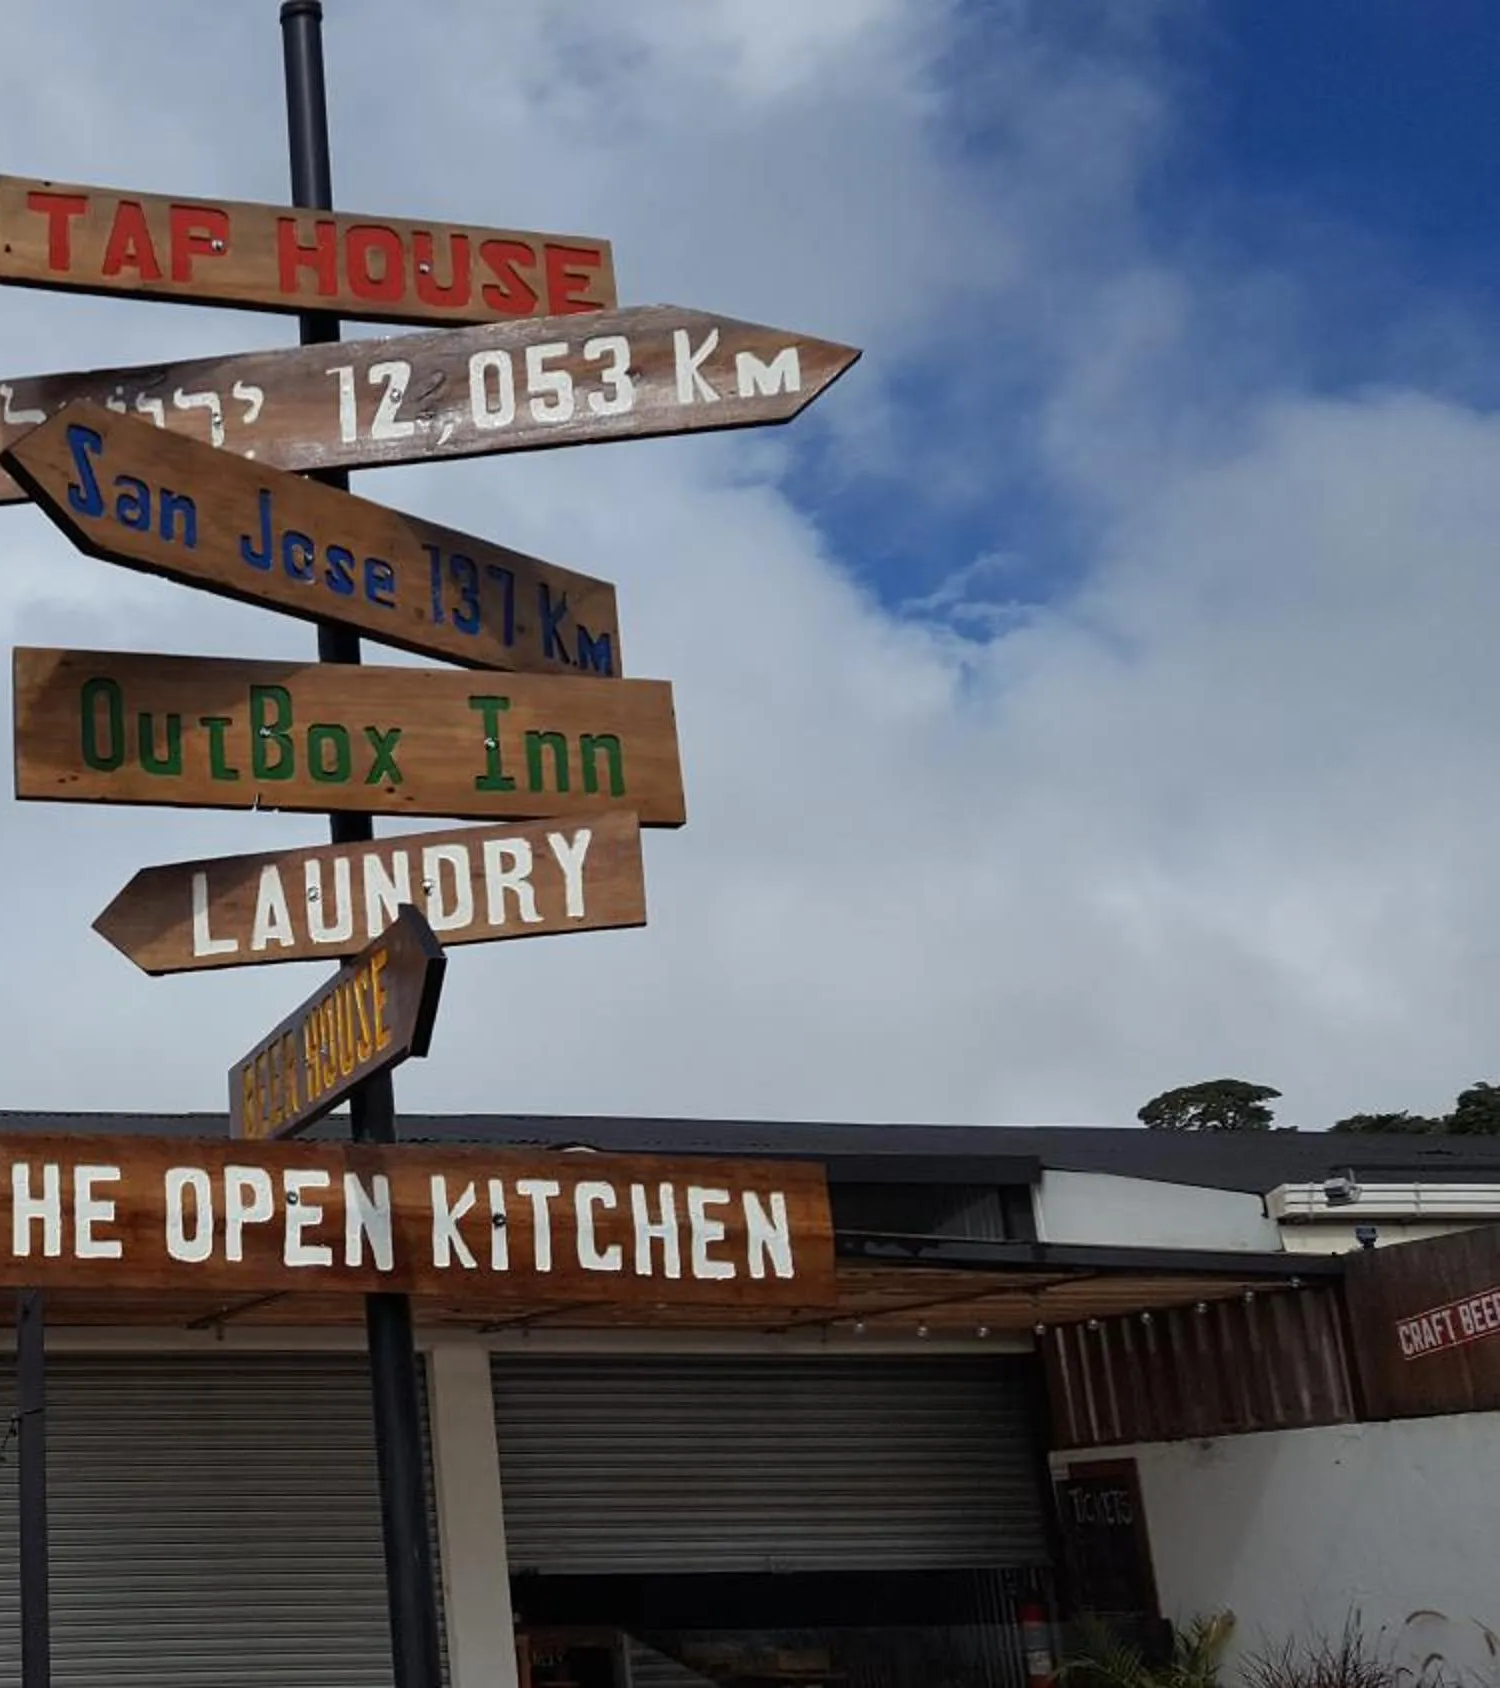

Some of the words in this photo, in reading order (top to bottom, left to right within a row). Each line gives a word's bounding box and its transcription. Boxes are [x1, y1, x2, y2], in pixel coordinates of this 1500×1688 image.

[27, 192, 228, 283] TAP
[277, 216, 605, 316] HOUSE
[325, 334, 633, 446] 12,053
[66, 423, 198, 550] San
[239, 487, 397, 609] Jose
[421, 543, 515, 648] 137
[467, 695, 627, 798] Inn
[191, 827, 593, 957] LAUNDRY
[303, 947, 393, 1103] HOUSE
[164, 1164, 395, 1272] OPEN
[430, 1174, 796, 1280] KITCHEN
[1398, 1309, 1456, 1356] CRAFT
